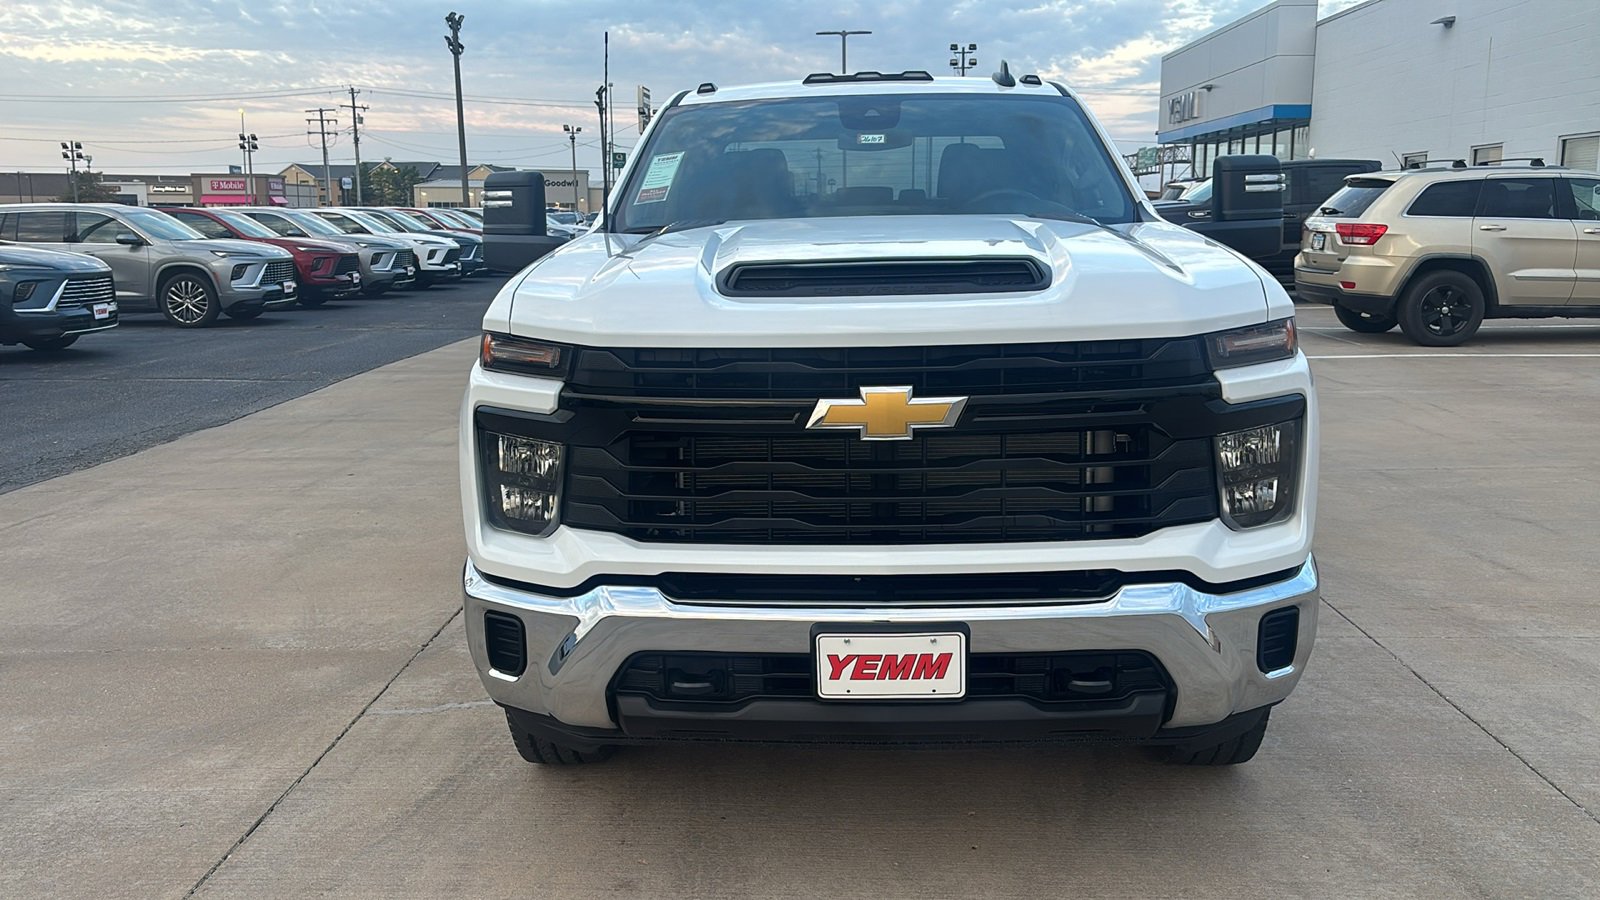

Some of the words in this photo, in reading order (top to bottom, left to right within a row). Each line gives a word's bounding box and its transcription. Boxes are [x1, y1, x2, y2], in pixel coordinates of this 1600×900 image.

[220, 181, 244, 189] Mobile
[544, 179, 579, 187] Goodwil
[827, 653, 953, 680] YEMM
